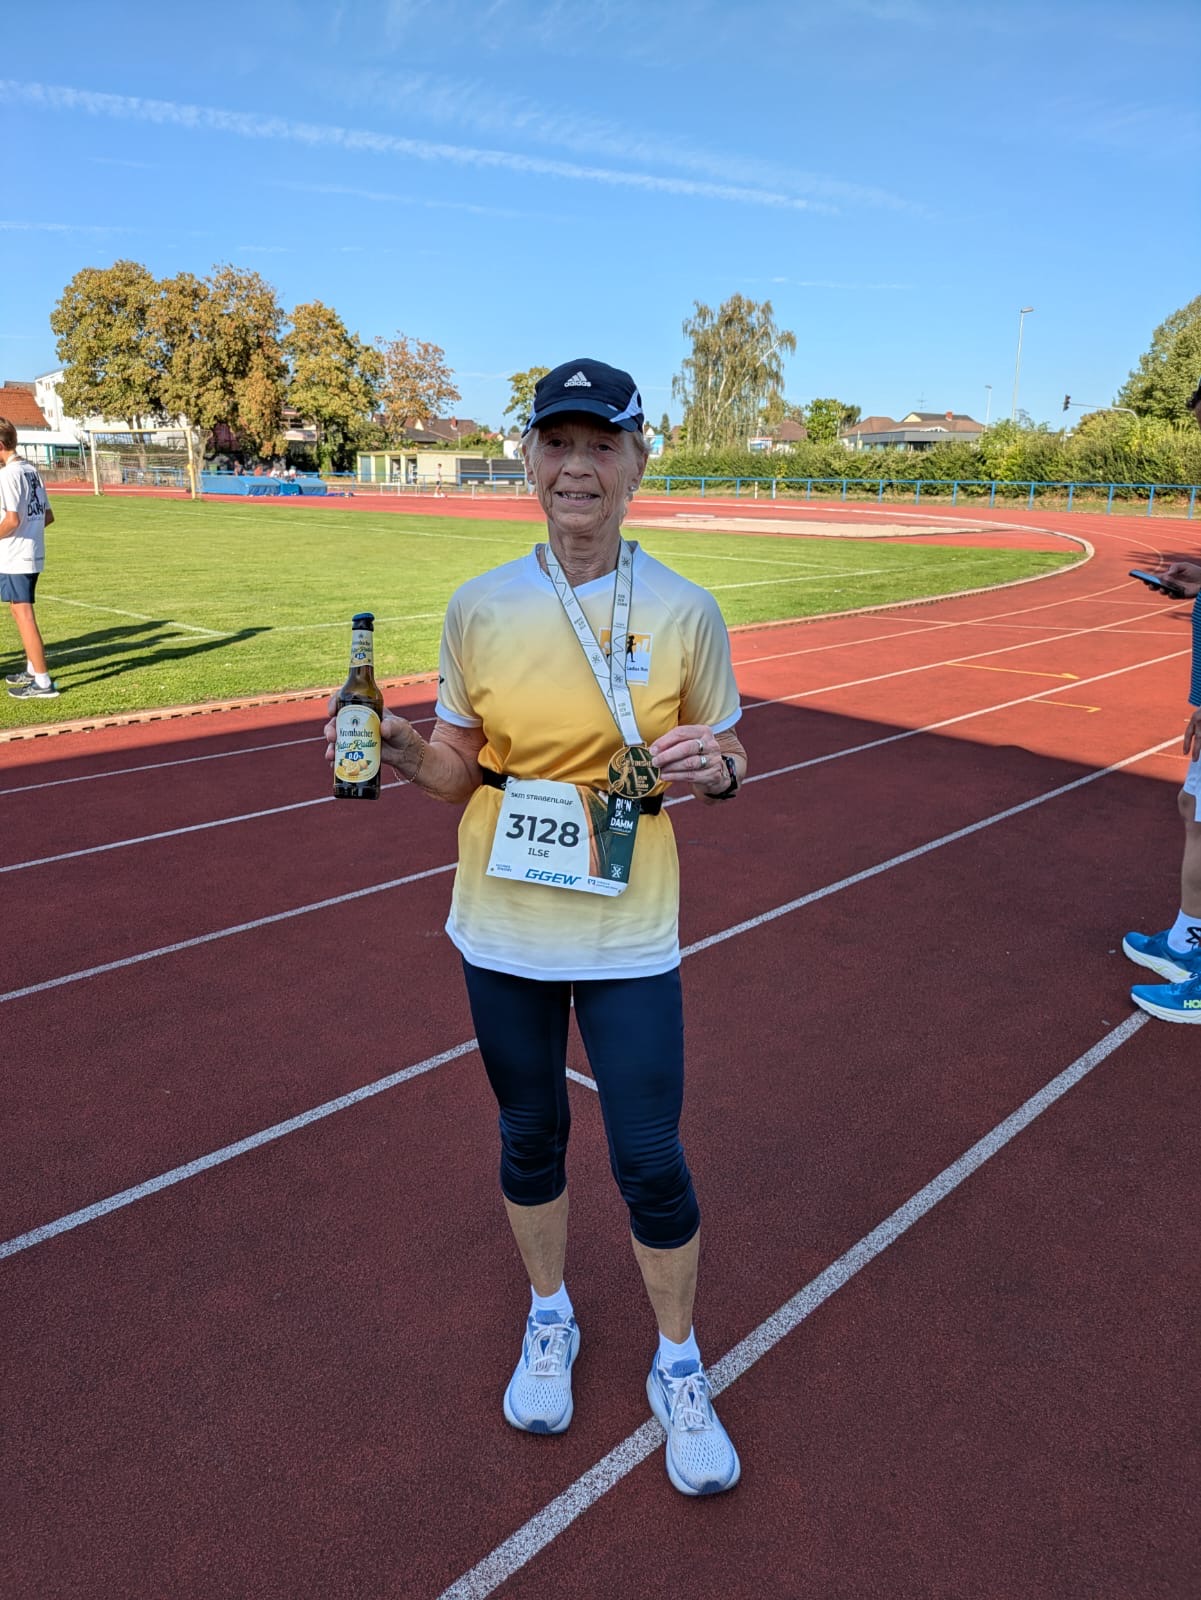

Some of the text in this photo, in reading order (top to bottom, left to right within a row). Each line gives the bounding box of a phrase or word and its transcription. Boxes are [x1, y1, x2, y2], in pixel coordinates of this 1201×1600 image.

[564, 380, 592, 388] adidas
[339, 728, 374, 738] Krombacher
[610, 817, 634, 830] DAMM
[505, 813, 580, 848] 3128
[528, 847, 550, 858] ILSE
[525, 868, 582, 886] GGEW
[1183, 1000, 1201, 1009] HO
